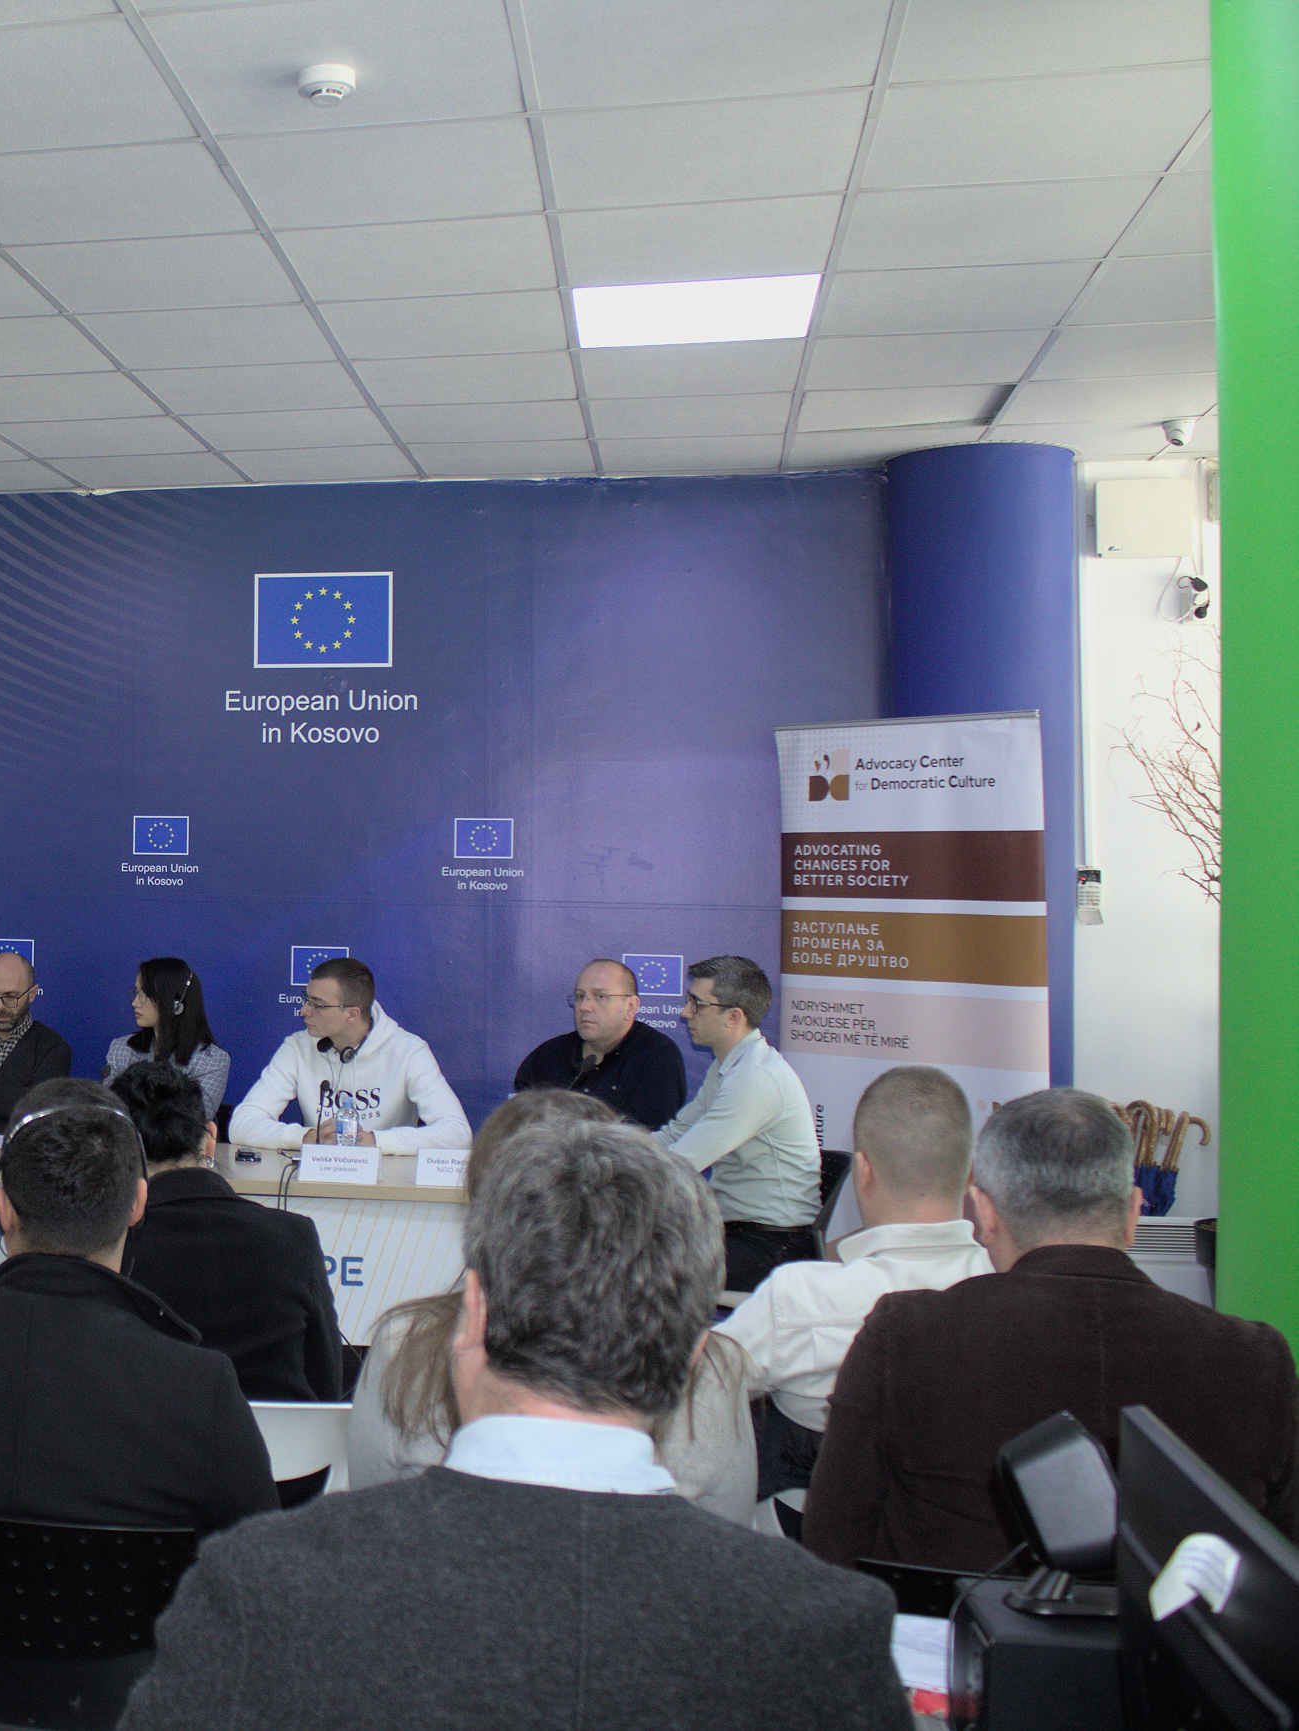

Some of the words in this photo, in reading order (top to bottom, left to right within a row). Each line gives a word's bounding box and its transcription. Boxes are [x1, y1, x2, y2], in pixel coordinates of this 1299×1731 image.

[225, 690, 339, 716] European
[349, 689, 418, 711] Union
[262, 722, 282, 743] in
[291, 722, 380, 744] Kosovo
[855, 757, 917, 771] Advocacy
[919, 755, 965, 769] Center
[854, 780, 868, 791] for
[870, 776, 946, 790] Democratic
[948, 774, 996, 788] Culture
[794, 844, 882, 856] ADVOCATING
[121, 862, 168, 874] European
[170, 863, 199, 873] Union
[441, 866, 491, 878] European
[494, 867, 524, 877] Union
[794, 859, 857, 871] CHANGES
[861, 859, 890, 871] FOR
[136, 876, 145, 885] in
[147, 876, 184, 886] Kosovo
[457, 880, 467, 890] in
[469, 880, 508, 891] Kosovo
[793, 874, 844, 886] BETTER
[847, 874, 909, 887] SOCIETY
[792, 921, 879, 936] ЗАСТУПАЊЕ
[792, 936, 861, 951] ПРОМЕНА
[866, 939, 885, 952] ЗА
[792, 952, 832, 965] БОЉЕ
[837, 954, 909, 969] ДРУШТВО
[791, 1000, 865, 1015] NDRYSHIMET
[791, 1014, 850, 1029] AVOKUESE
[852, 1016, 876, 1031] PËR
[790, 1029, 841, 1044] SHOQËRI
[843, 1031, 862, 1045] MË
[863, 1032, 879, 1047] TË
[880, 1034, 910, 1049] MIRË
[815, 1104, 824, 1151] ulture
